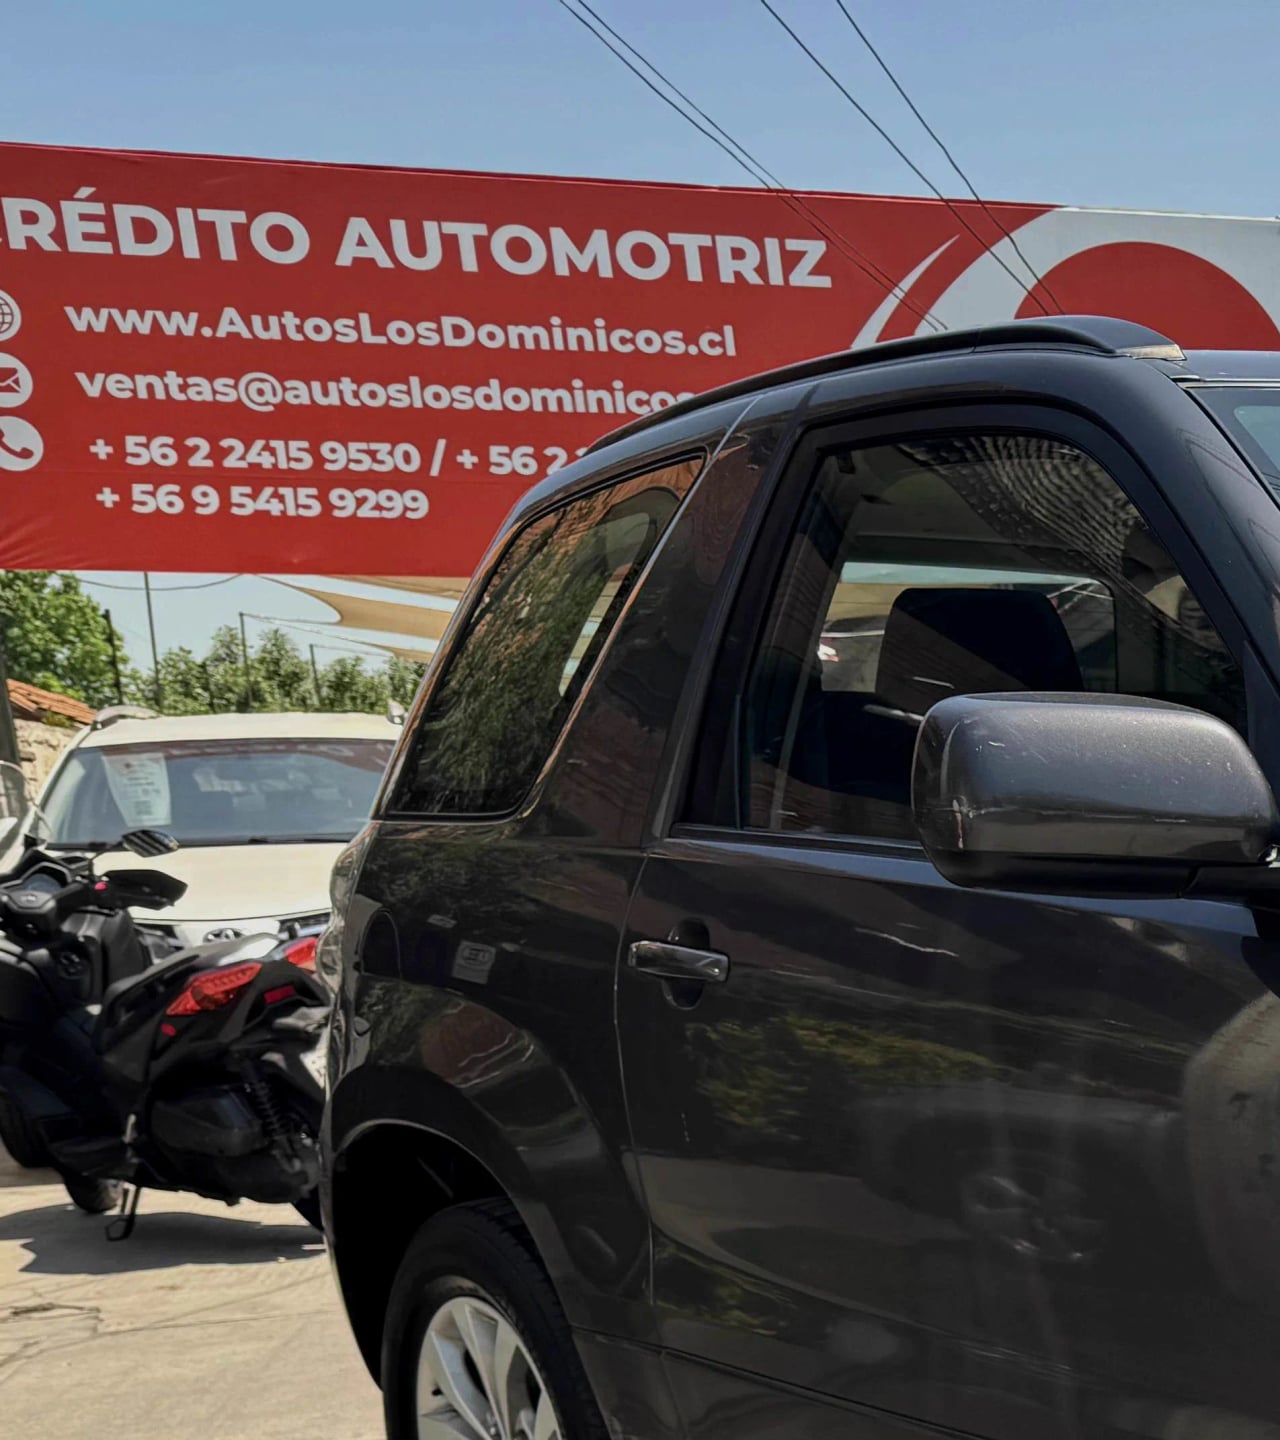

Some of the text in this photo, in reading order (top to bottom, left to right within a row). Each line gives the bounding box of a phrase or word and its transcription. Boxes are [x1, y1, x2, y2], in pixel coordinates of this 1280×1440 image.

[0, 186, 832, 288] RÉDITO AUTOMOTRIZ
[63, 306, 737, 357] www.AutosLosDominicos.cl
[89, 438, 114, 460] +
[125, 435, 178, 467] 56
[184, 436, 214, 468] 2
[219, 437, 314, 471] 2415
[319, 440, 421, 473] 9530
[489, 445, 538, 476] 56
[95, 483, 429, 520] + 56 9 5415 9299
